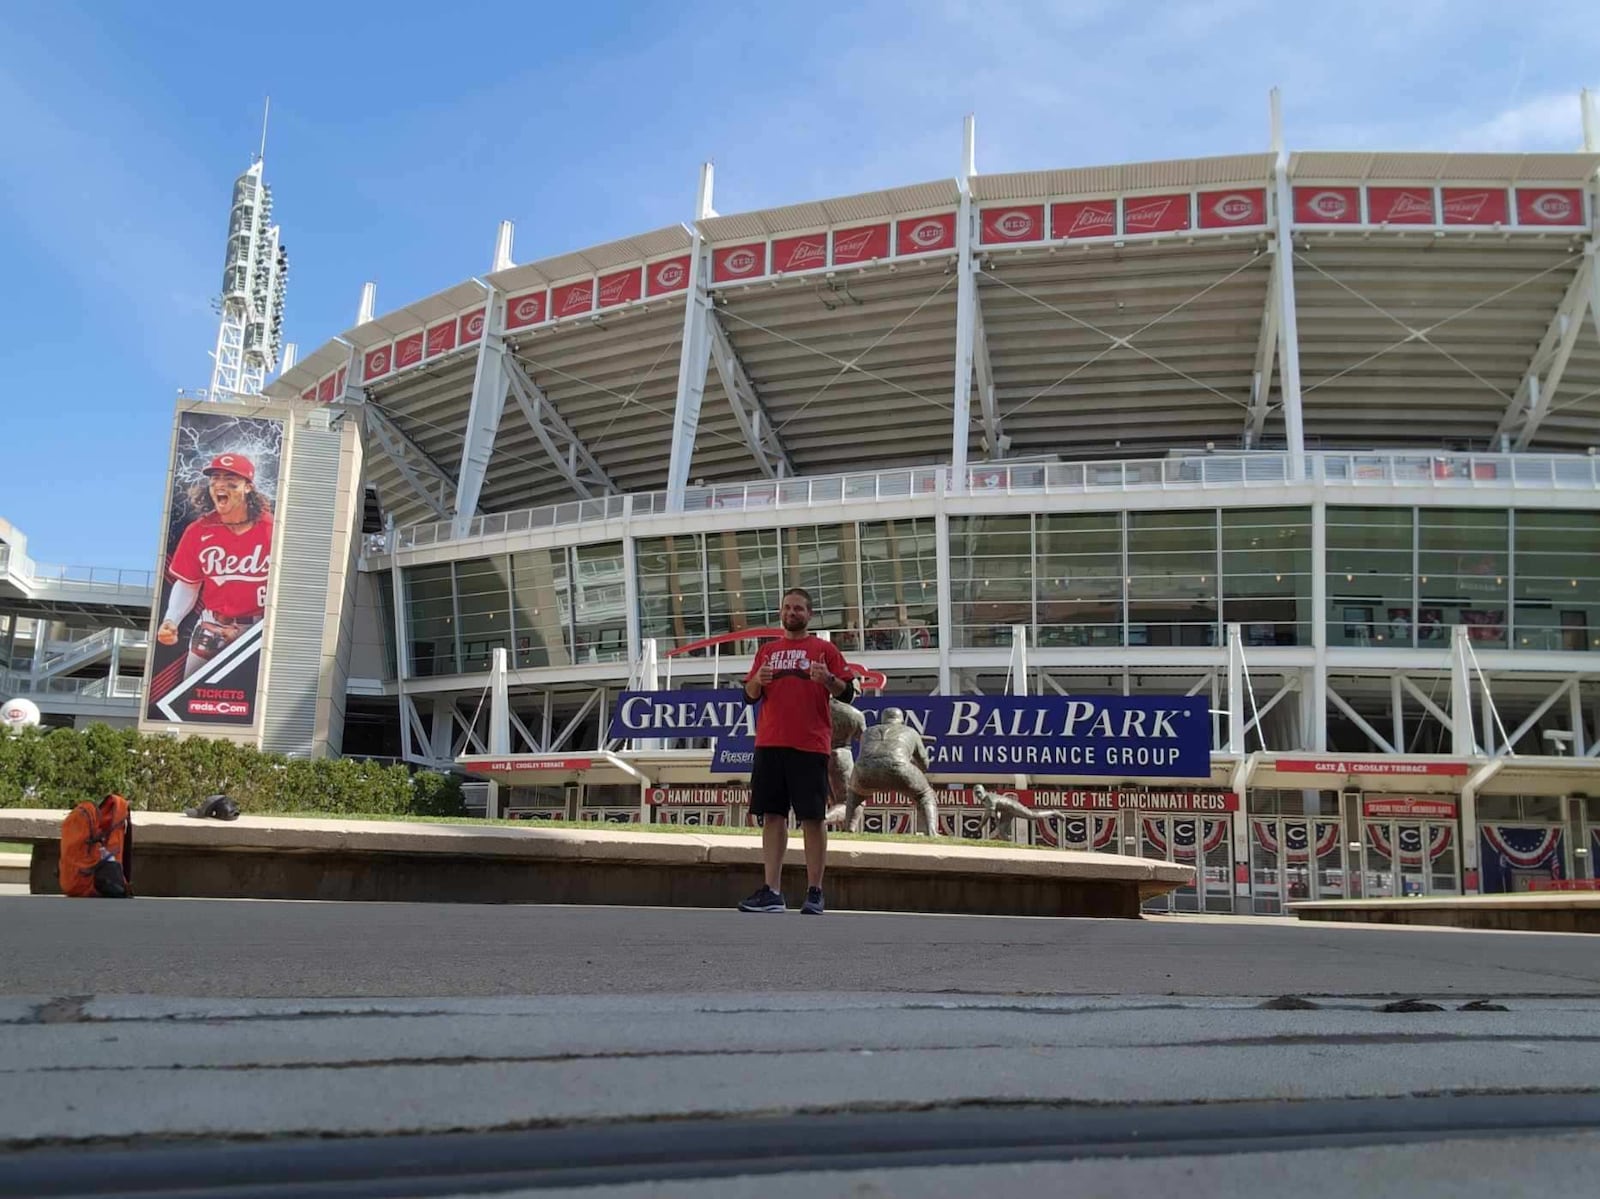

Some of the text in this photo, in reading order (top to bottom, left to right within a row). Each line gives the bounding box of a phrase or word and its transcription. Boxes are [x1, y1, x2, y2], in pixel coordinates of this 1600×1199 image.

[199, 544, 271, 575] Reds
[787, 650, 807, 659] YOUR
[196, 688, 245, 699] TICKETS
[621, 697, 742, 729] GREAT
[945, 701, 1053, 736] BALL
[974, 745, 1095, 764] INSURANCE
[1106, 747, 1180, 766] GROUP
[1315, 763, 1336, 771] GATE
[1337, 762, 1346, 772] A
[1391, 764, 1427, 772] TERRACE
[668, 789, 718, 804] HAMILTON
[722, 789, 752, 803] COUN
[1034, 792, 1068, 807] HOME
[1072, 792, 1086, 807] OF
[1091, 793, 1113, 808] THE
[1118, 793, 1188, 809] CINCINNATI
[1193, 794, 1225, 810] REDS
